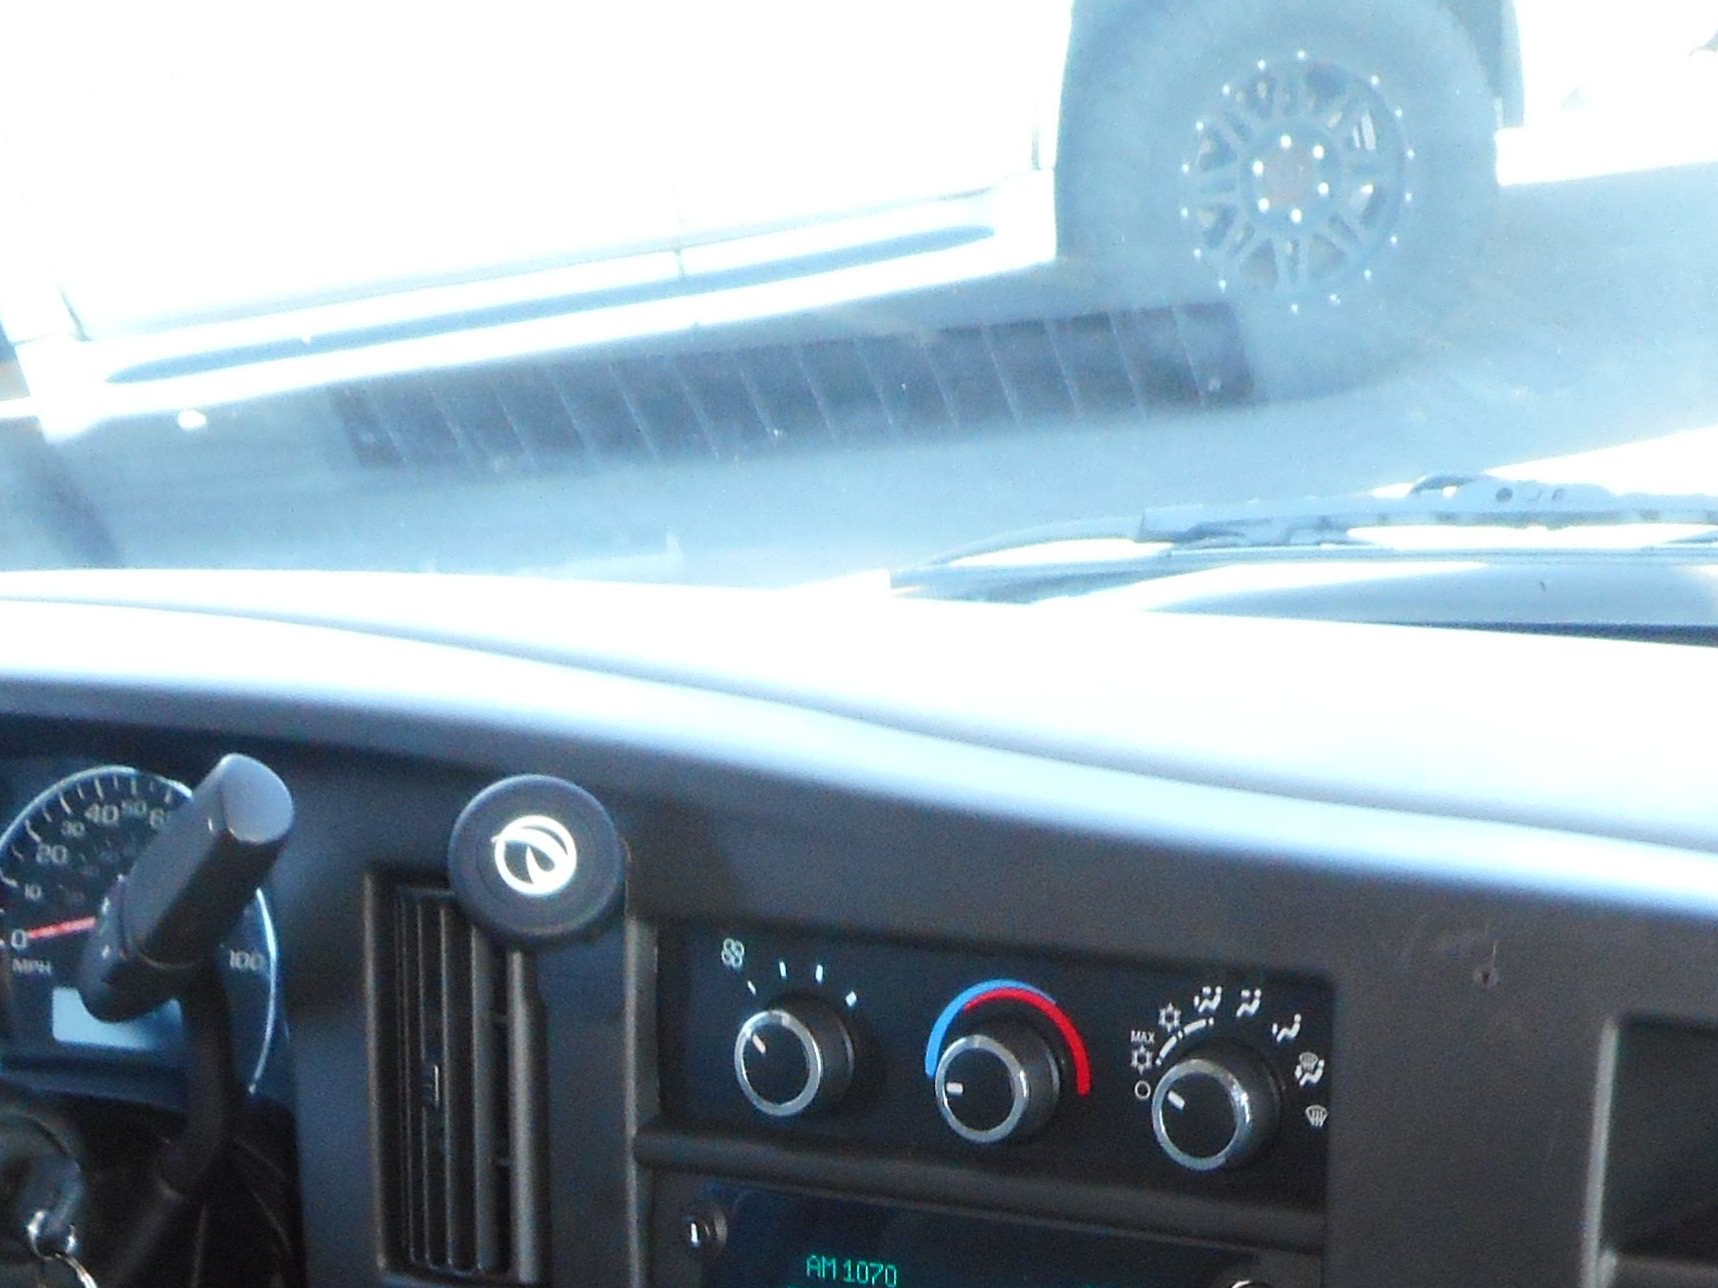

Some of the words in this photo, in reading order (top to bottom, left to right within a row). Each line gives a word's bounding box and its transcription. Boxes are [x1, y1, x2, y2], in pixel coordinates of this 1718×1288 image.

[85, 802, 119, 823] 40
[36, 844, 69, 865] 20
[24, 883, 42, 899] 10
[10, 929, 27, 949] 0
[12, 958, 53, 976] MPH
[229, 949, 265, 970] 100
[1130, 1029, 1155, 1043] MAX
[806, 1255, 837, 1281] AM
[843, 1260, 897, 1288] 1070
